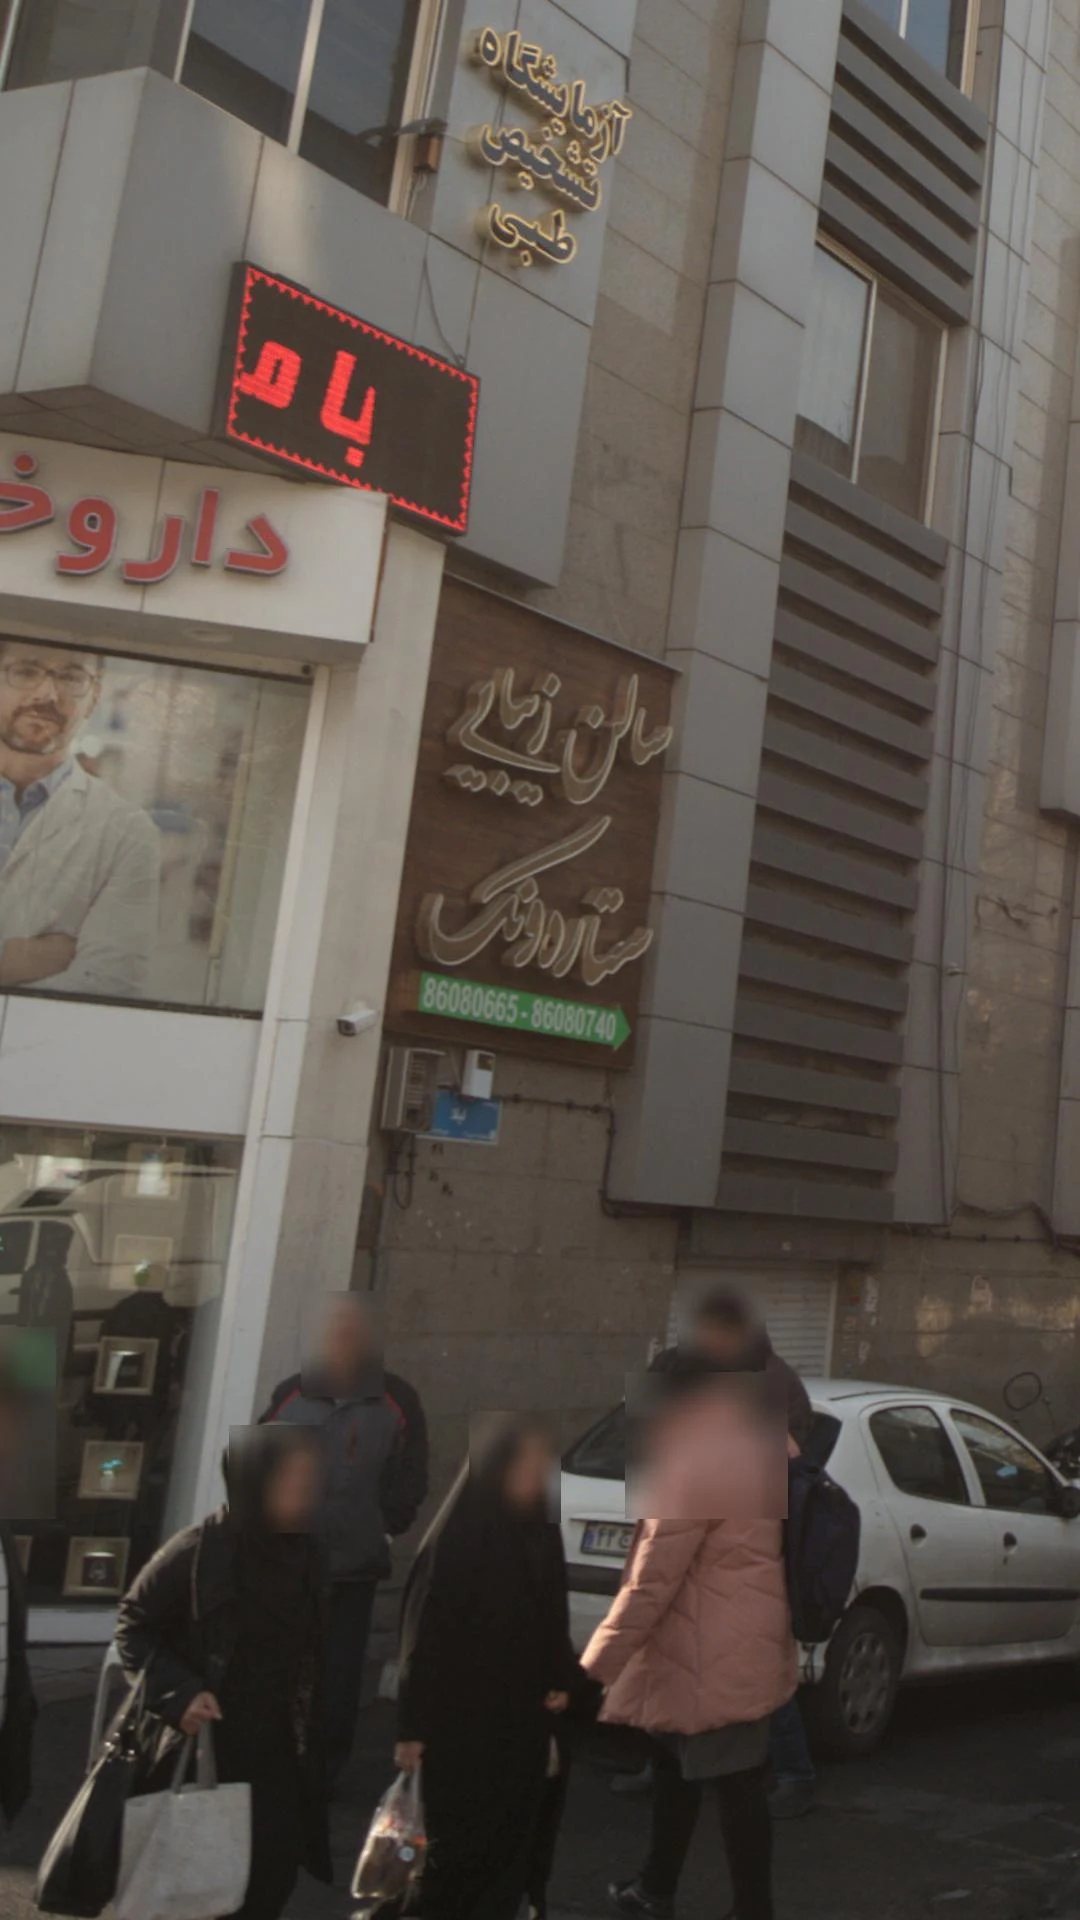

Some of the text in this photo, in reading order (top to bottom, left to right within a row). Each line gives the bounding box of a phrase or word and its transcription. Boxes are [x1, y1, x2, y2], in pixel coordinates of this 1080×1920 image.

[478, 27, 633, 164] آزمایشگاه
[480, 124, 602, 211] تشخیص
[488, 203, 577, 267] طبی
[0, 451, 290, 585] داروخ
[558, 672, 673, 805] سالن
